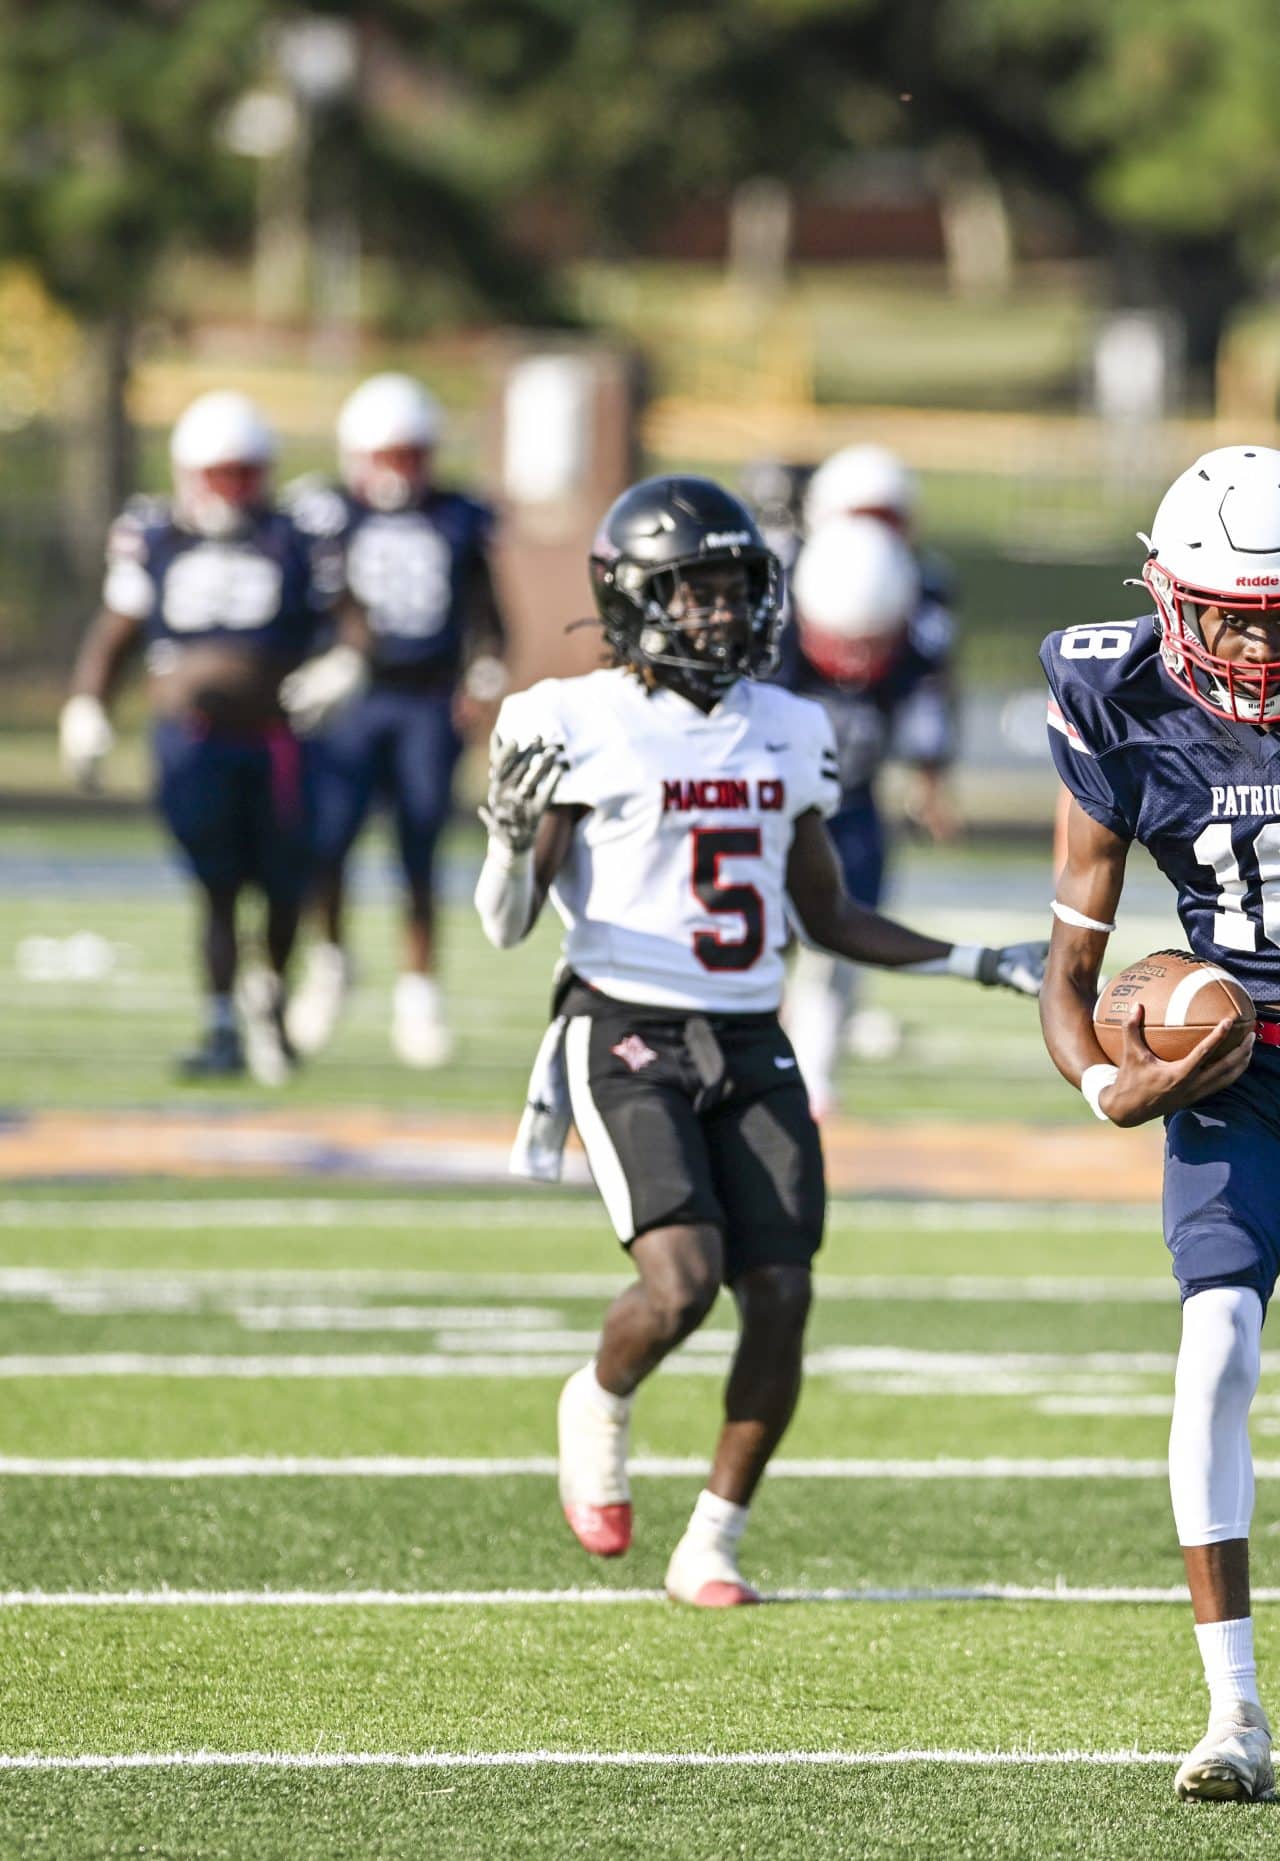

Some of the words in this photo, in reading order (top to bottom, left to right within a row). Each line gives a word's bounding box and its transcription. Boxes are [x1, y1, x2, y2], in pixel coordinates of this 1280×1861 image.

[662, 780, 749, 812] MACON
[757, 779, 786, 812] CO
[690, 826, 765, 974] 5
